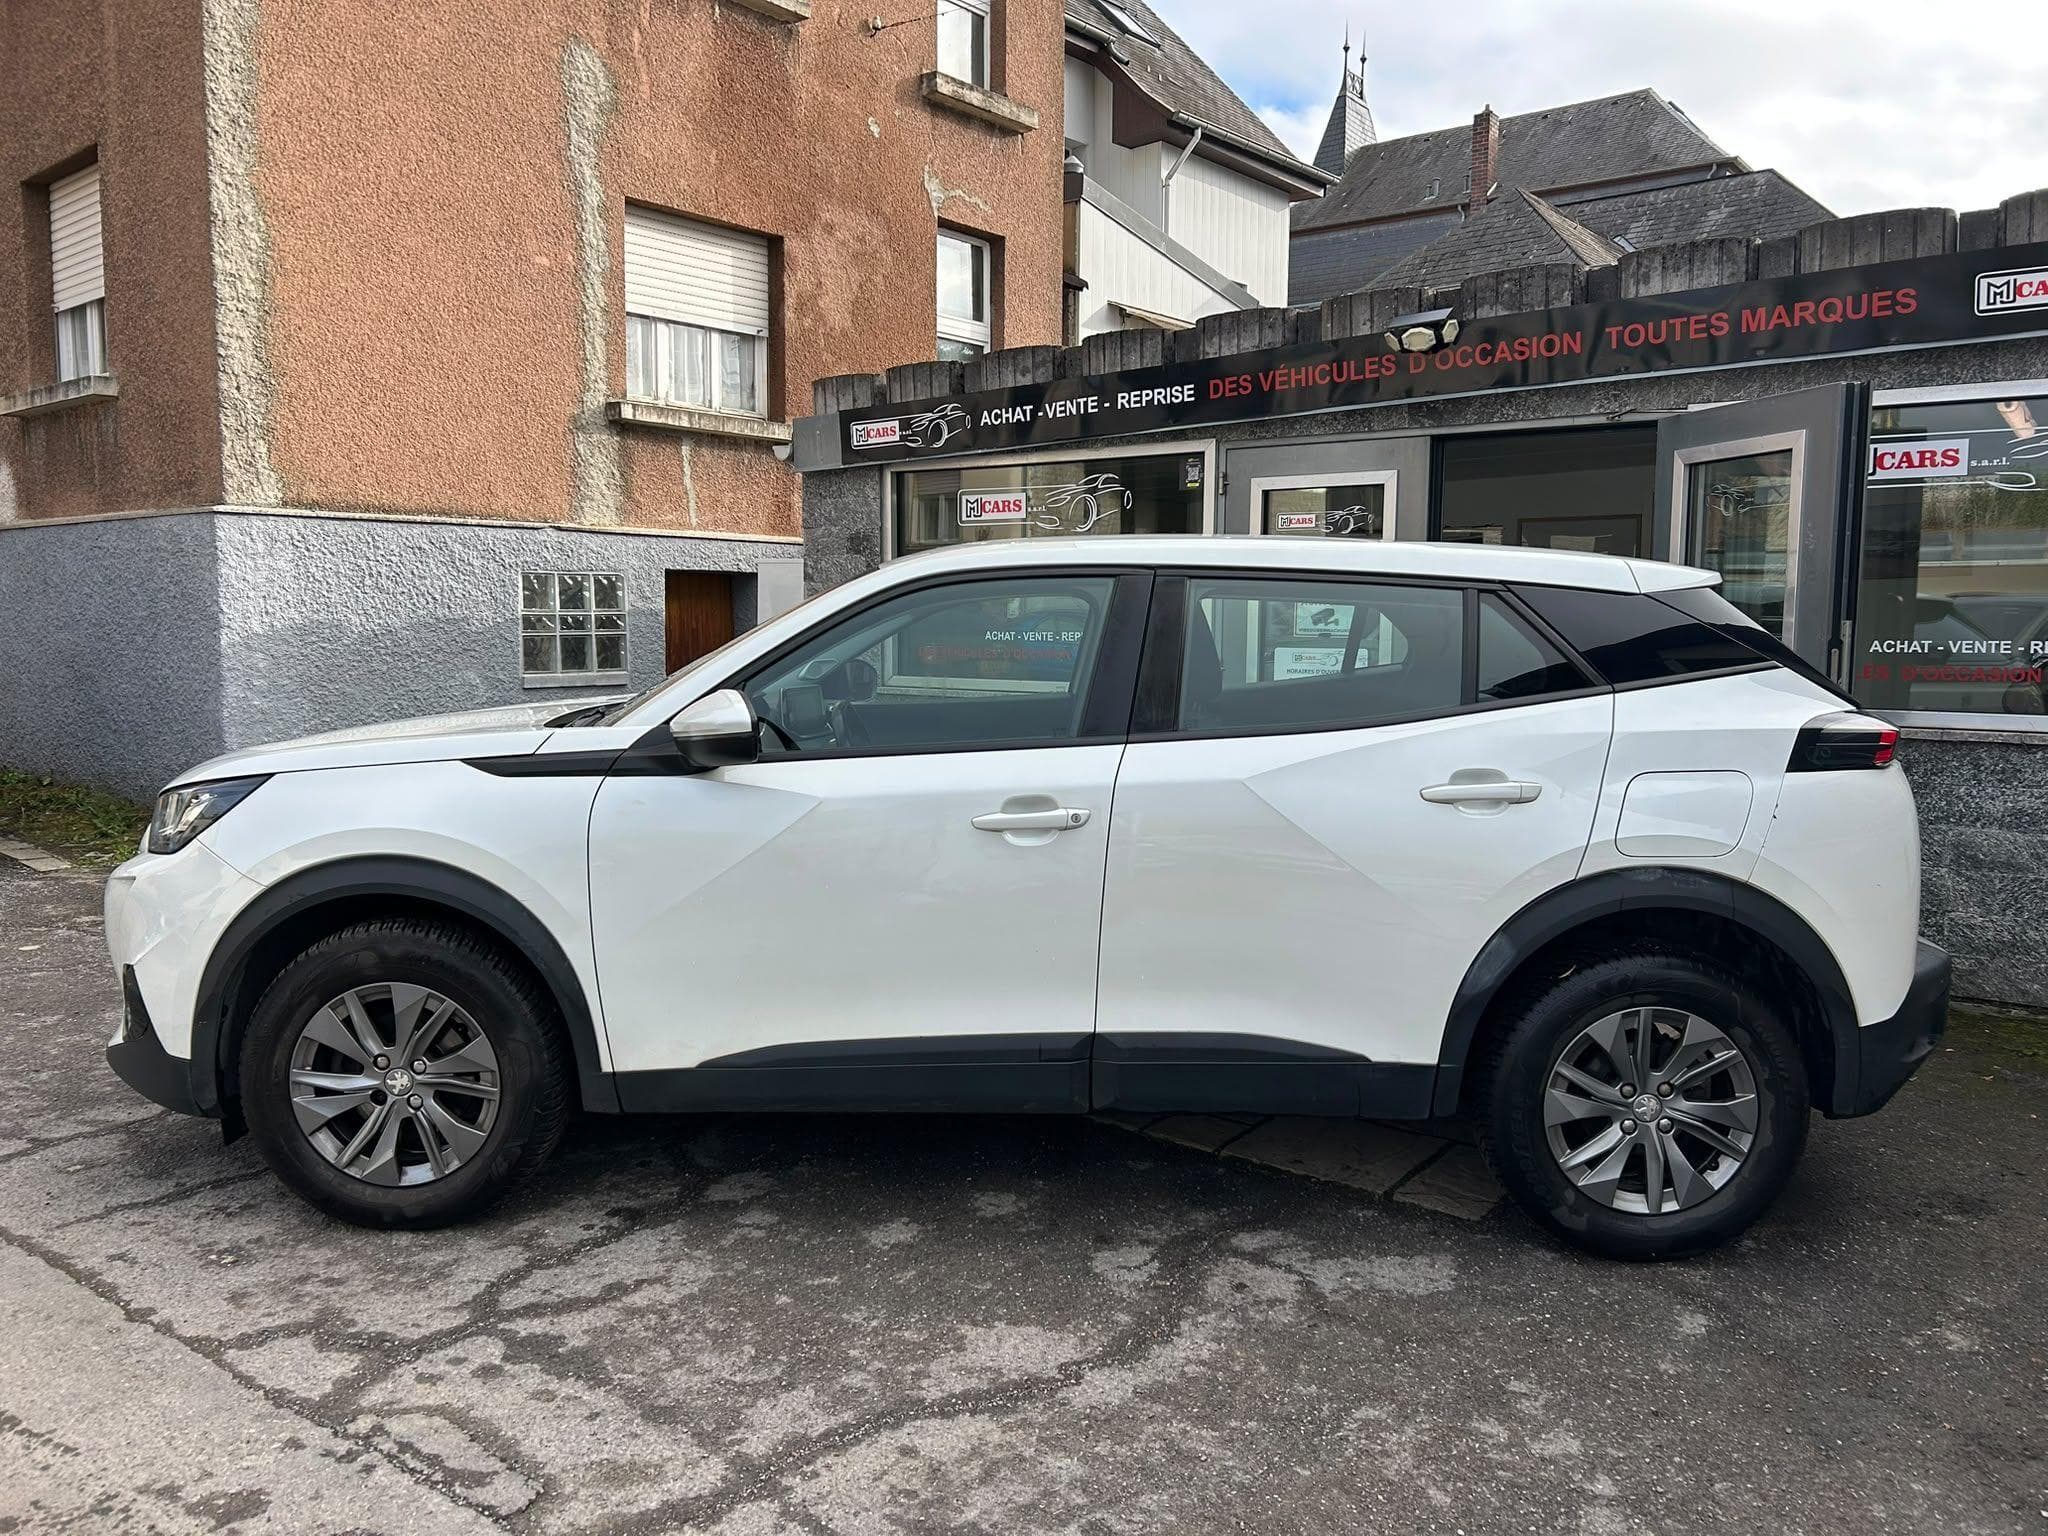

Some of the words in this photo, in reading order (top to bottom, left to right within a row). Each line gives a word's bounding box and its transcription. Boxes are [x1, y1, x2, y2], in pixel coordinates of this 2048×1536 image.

[980, 405, 1034, 427] ACHAT
[1045, 396, 1099, 419] VENTE
[1117, 384, 1195, 410] REPRISE
[1209, 375, 1252, 400] DES
[1259, 353, 1397, 391] VÉHICULES
[1409, 331, 1583, 375] D'OCCASION
[1606, 311, 1729, 350] TOUTES
[1741, 287, 1918, 333] MARQUES
[1877, 448, 1960, 470] CARS
[982, 499, 1022, 513] CARS
[1290, 517, 1314, 525] CARS
[984, 631, 1016, 641] ACHAT
[1023, 631, 1054, 642] VENTE
[1869, 640, 1932, 653] ACHAT
[1949, 640, 2012, 654] VENTE
